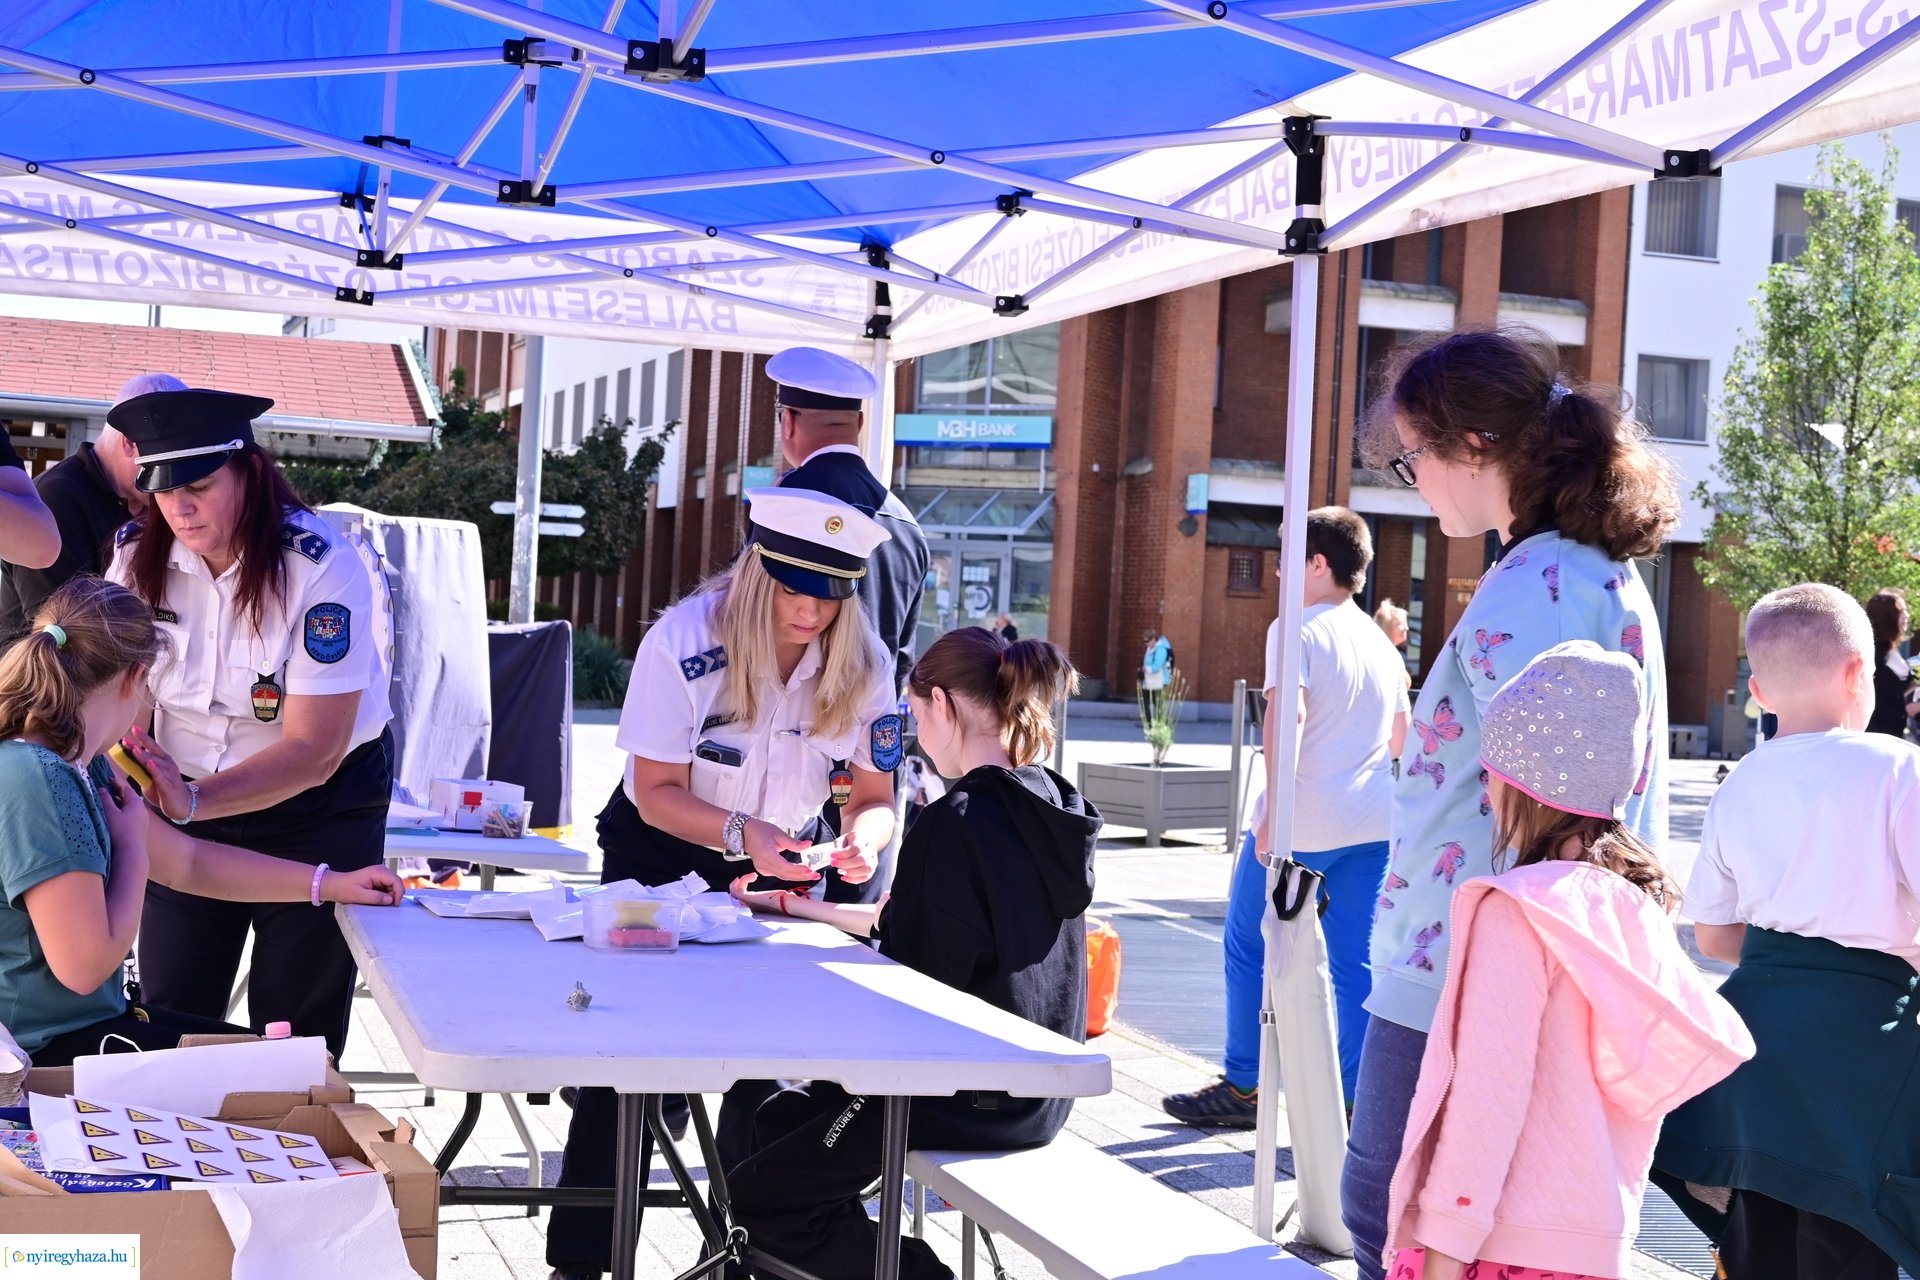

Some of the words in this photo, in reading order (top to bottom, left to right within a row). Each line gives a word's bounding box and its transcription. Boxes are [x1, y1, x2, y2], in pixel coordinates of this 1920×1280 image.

[937, 419, 977, 438] MBH
[978, 422, 1017, 437] BANK
[314, 606, 344, 617] POLICE
[877, 718, 898, 729] POLICE
[826, 1111, 855, 1148] CULTURE
